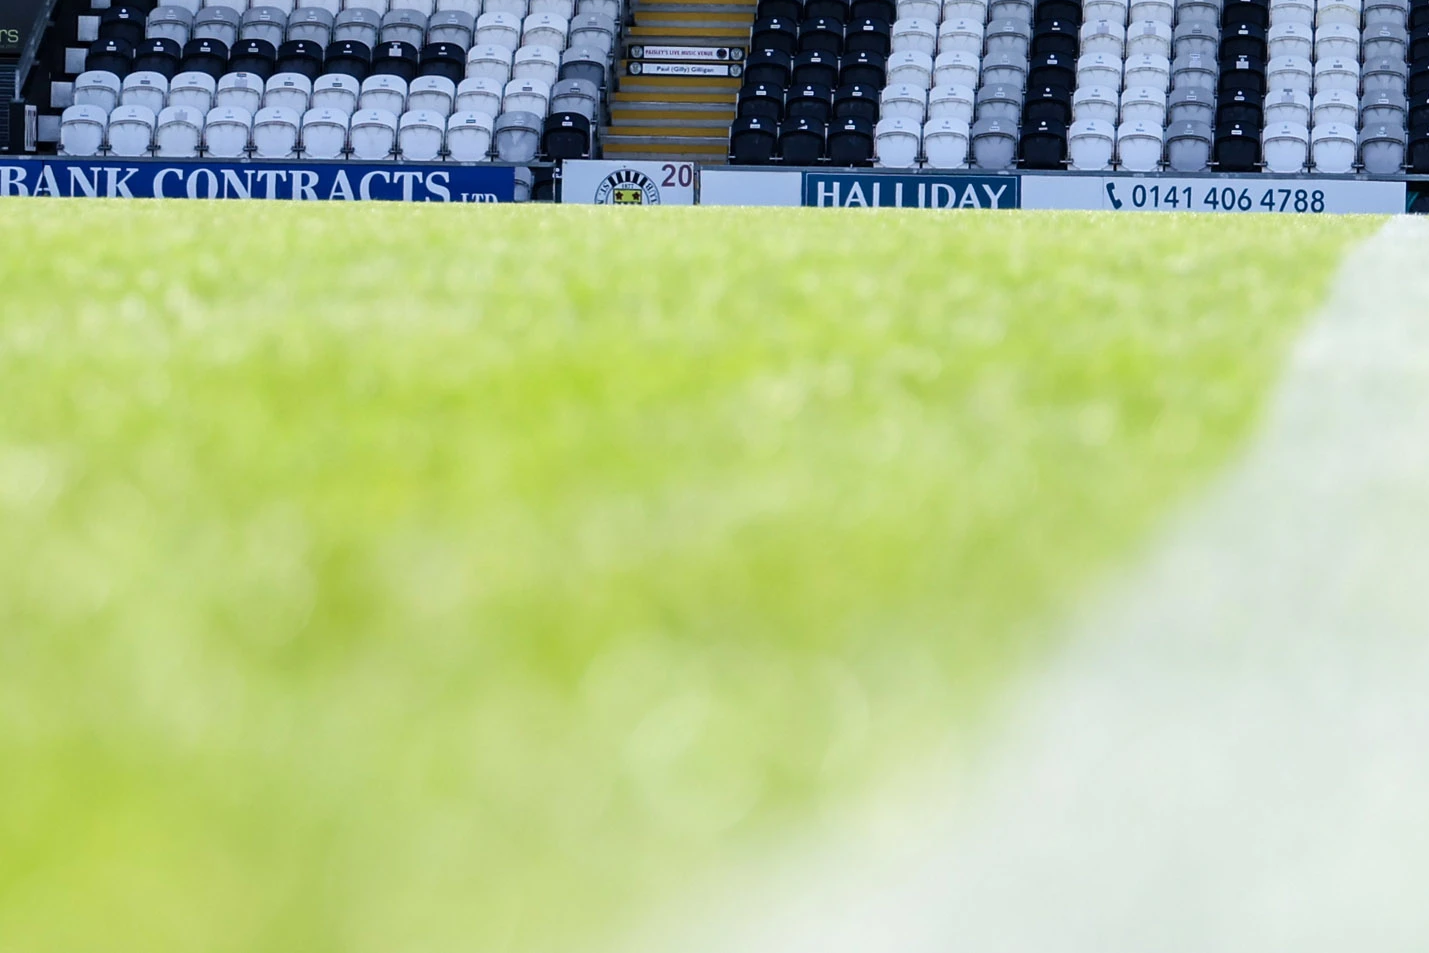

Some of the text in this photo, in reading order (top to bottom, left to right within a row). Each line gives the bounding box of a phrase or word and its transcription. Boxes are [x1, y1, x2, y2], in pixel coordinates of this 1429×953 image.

[0, 165, 139, 198] BANK
[153, 168, 450, 202] CONTRACTS
[661, 164, 692, 187] 20
[817, 181, 1007, 209] HALLIDAY
[1132, 184, 1324, 213] 0141 406 4788
